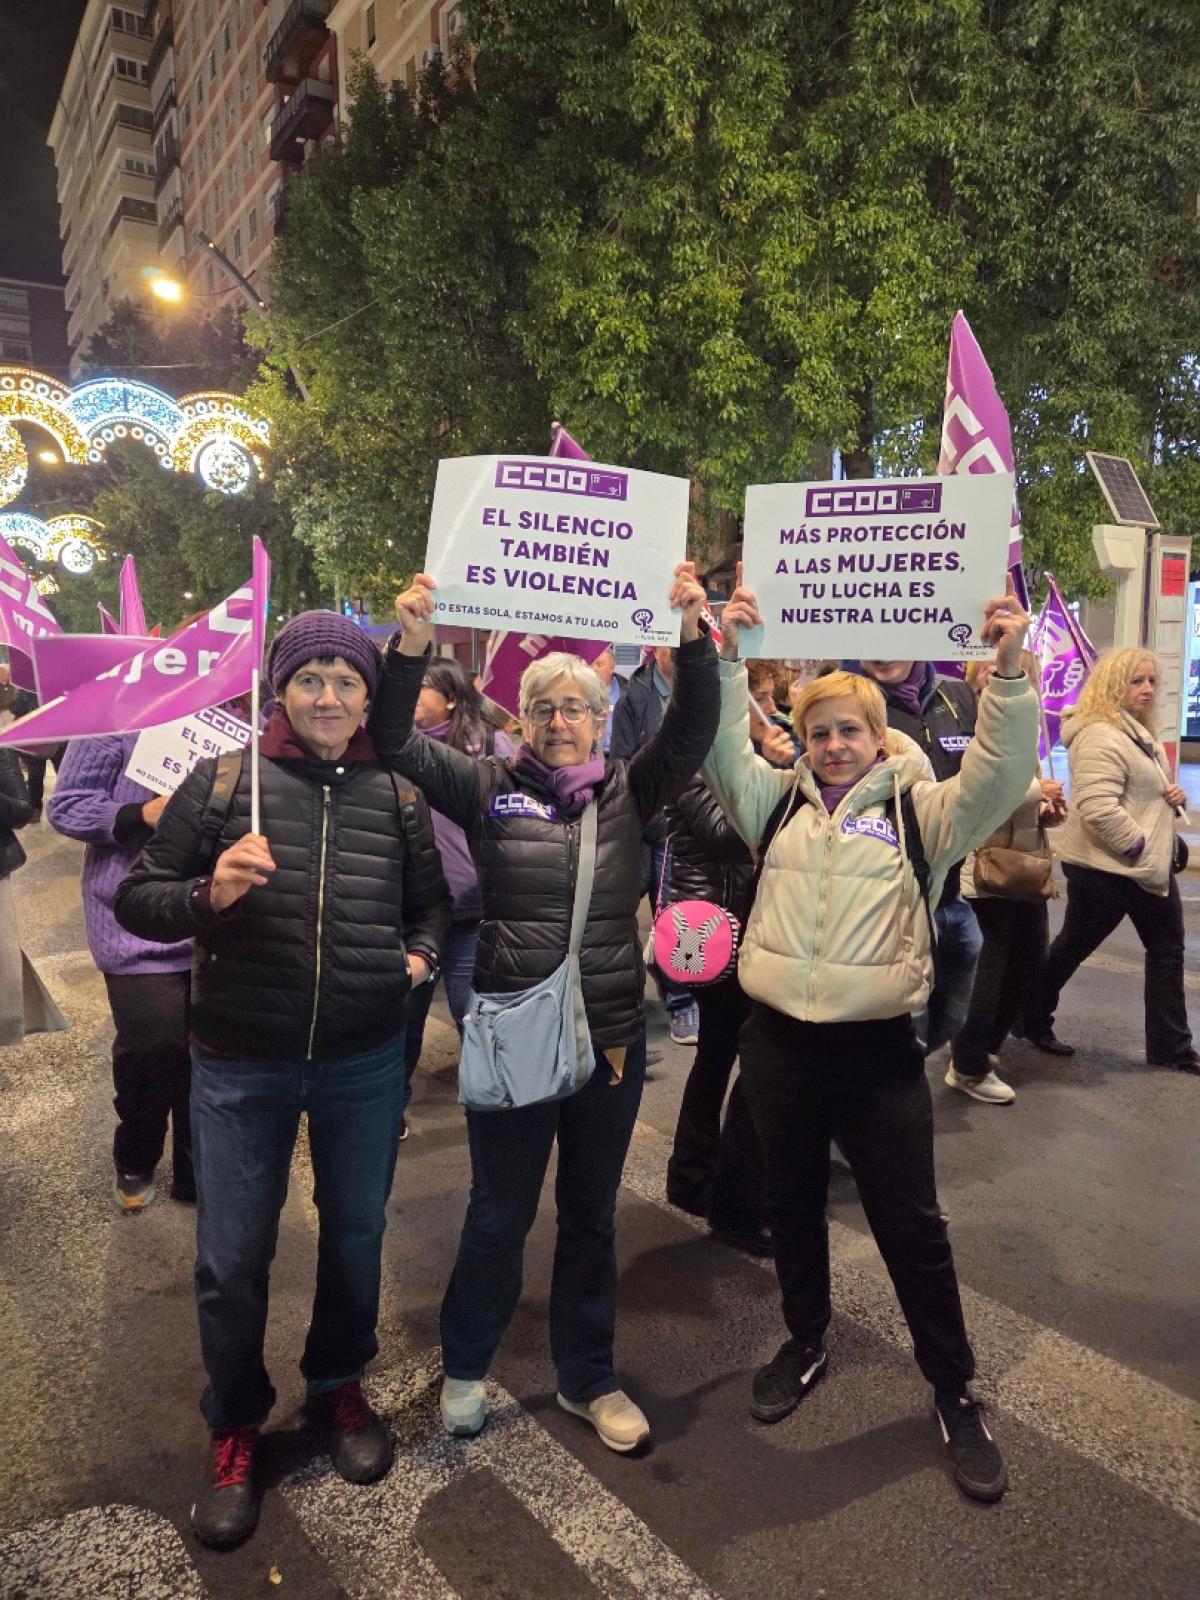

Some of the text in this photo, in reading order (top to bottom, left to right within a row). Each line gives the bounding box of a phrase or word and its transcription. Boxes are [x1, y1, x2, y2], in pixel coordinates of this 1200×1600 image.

[502, 465, 588, 491] CCOO
[811, 490, 898, 513] CCOO
[482, 507, 634, 540] EL SILENCIO
[780, 519, 967, 544] MÁS PROTECCIÓN
[500, 538, 610, 568] TAMBIÉN
[775, 551, 965, 574] A LAS MUJERES,
[466, 565, 638, 601] ES VIOLENCIA
[800, 581, 935, 599] TU LUCHA ES
[448, 604, 481, 615] ESTAS
[515, 610, 564, 623] ESTAMOS
[565, 616, 573, 625] A
[574, 617, 589, 626] TU
[590, 618, 619, 629] LADO
[781, 607, 954, 624] NUESTRA LUCHA
[181, 727, 199, 744] EL
[162, 756, 182, 774] ES
